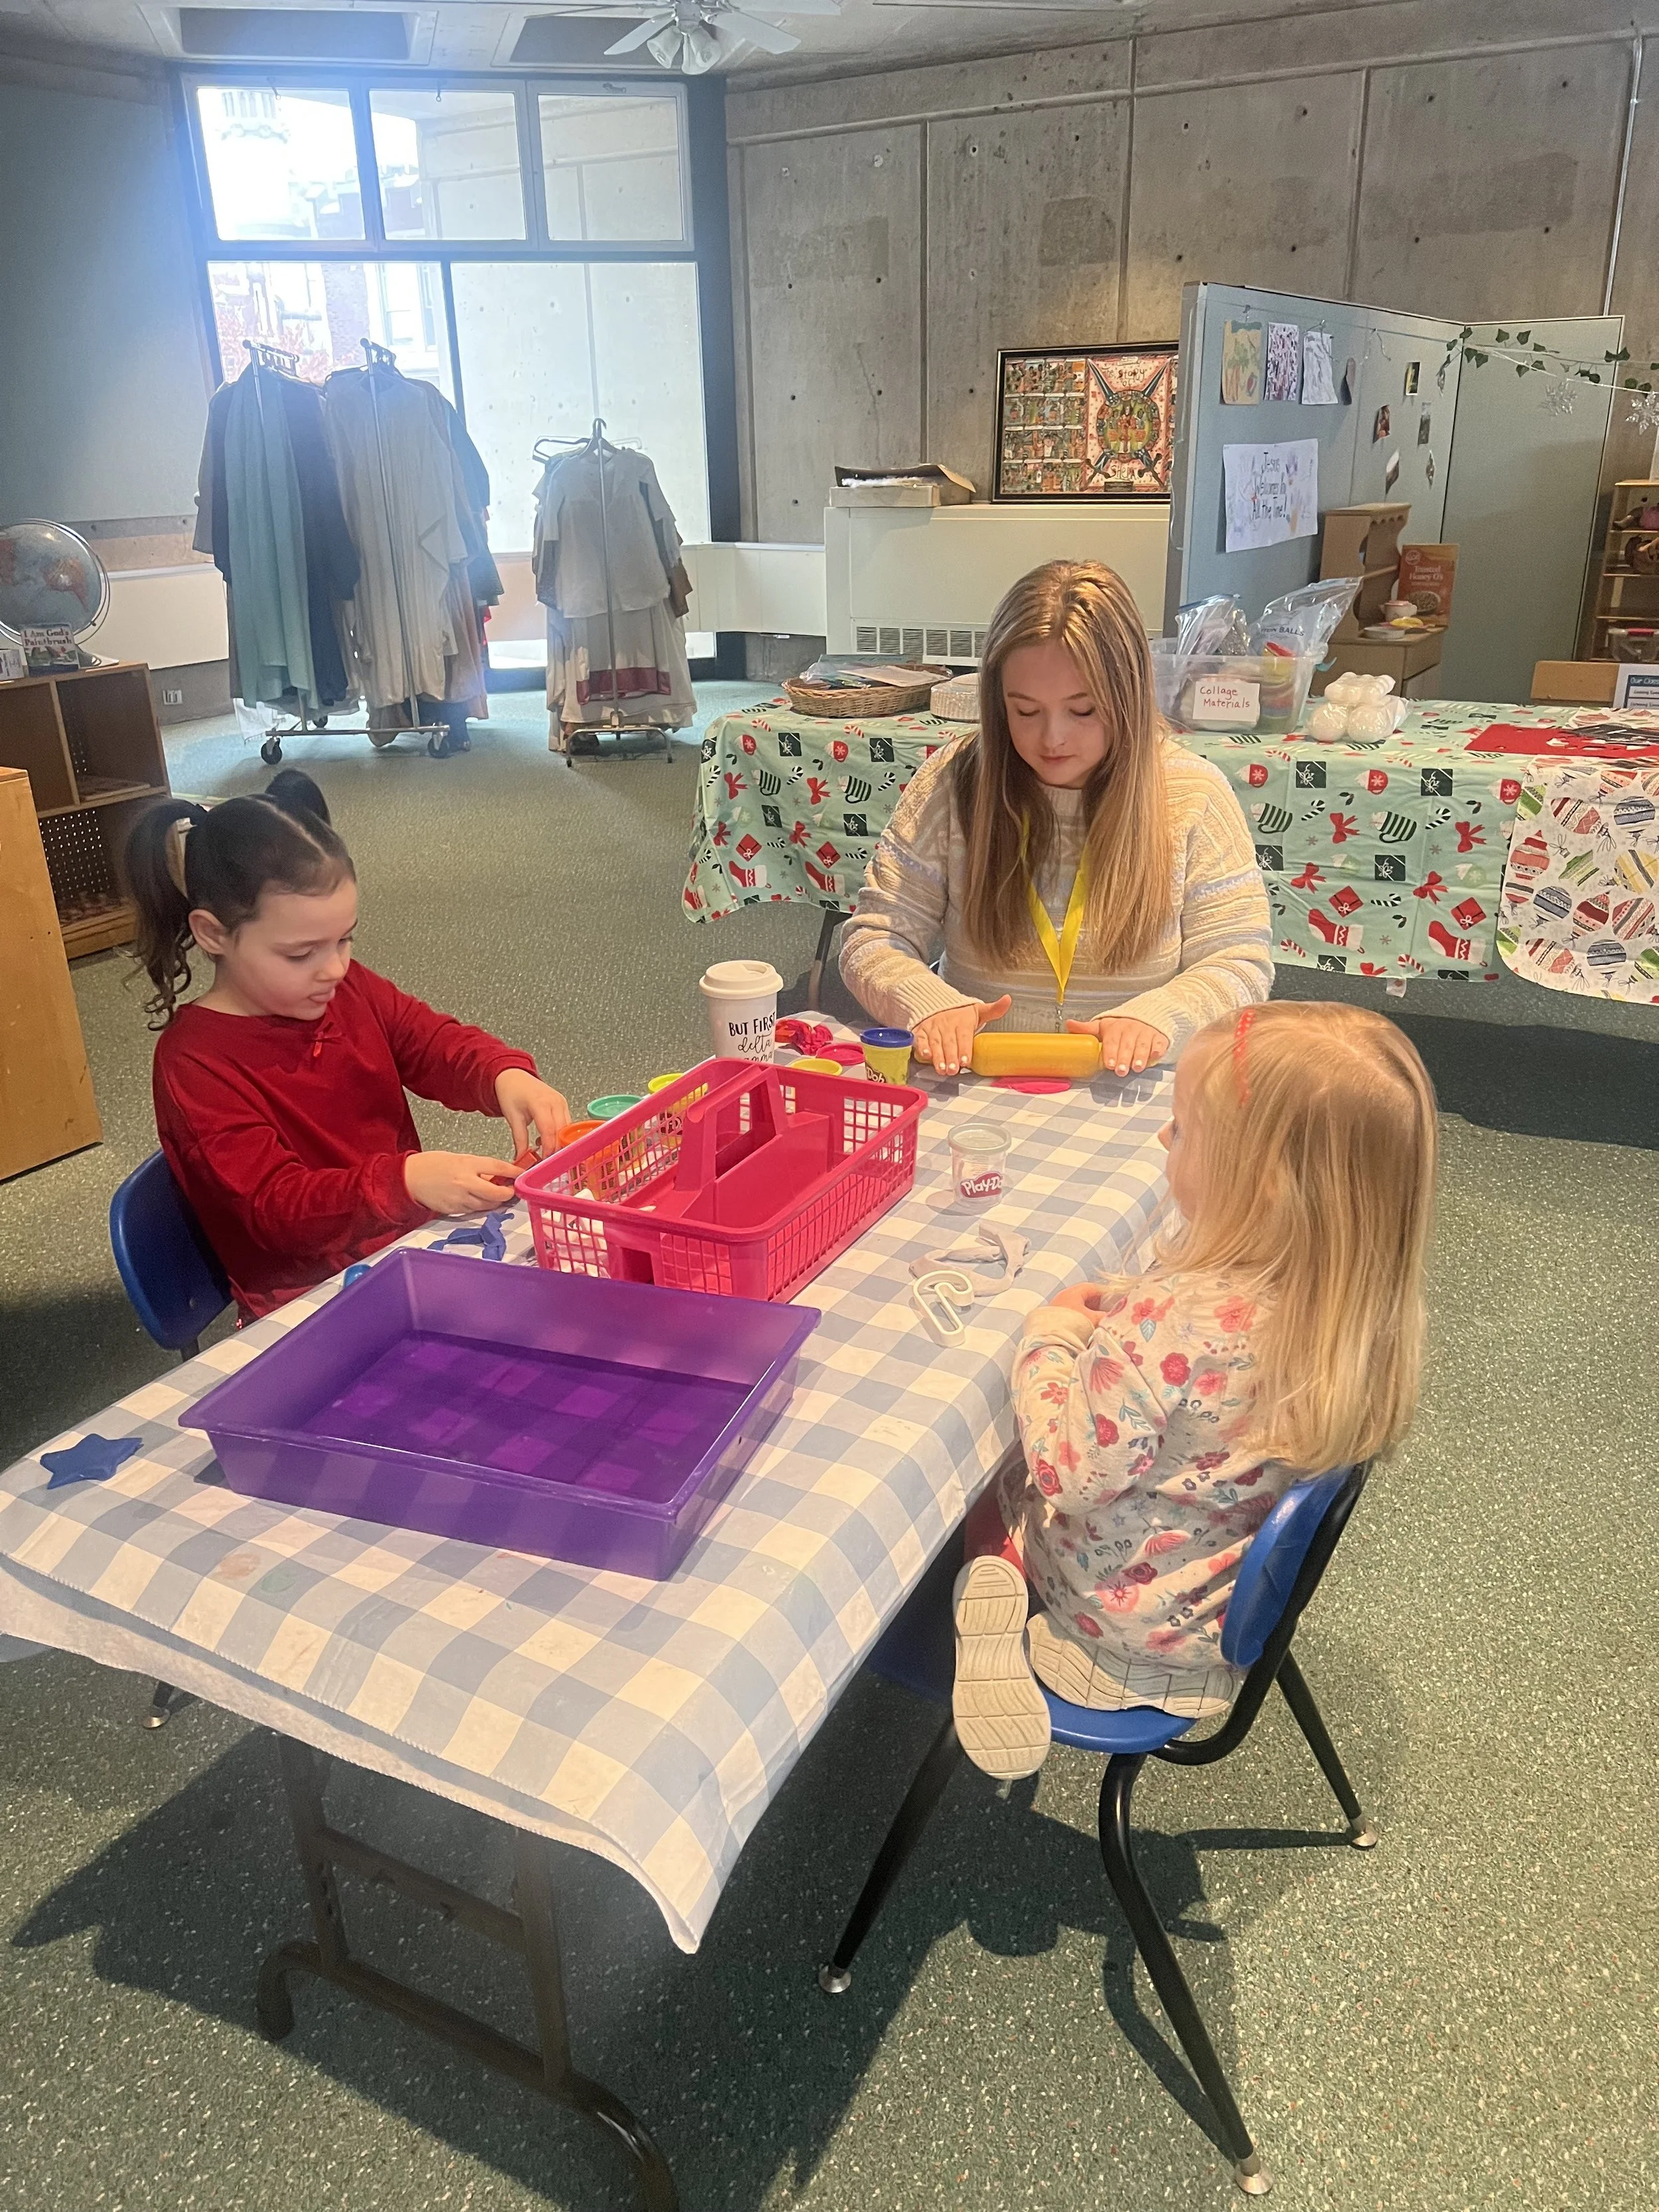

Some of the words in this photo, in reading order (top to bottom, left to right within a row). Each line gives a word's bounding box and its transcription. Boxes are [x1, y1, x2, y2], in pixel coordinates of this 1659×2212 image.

[46, 627, 69, 637] God's
[1279, 627, 1305, 636] BALLS
[25, 636, 72, 646] Paintbrush
[1200, 686, 1238, 700] Collage
[1203, 697, 1250, 709] Materials
[729, 1021, 749, 1037] BUT
[753, 1011, 776, 1035] FIRST
[737, 1030, 772, 1054] delta
[961, 1175, 1003, 1196] Play-Do
